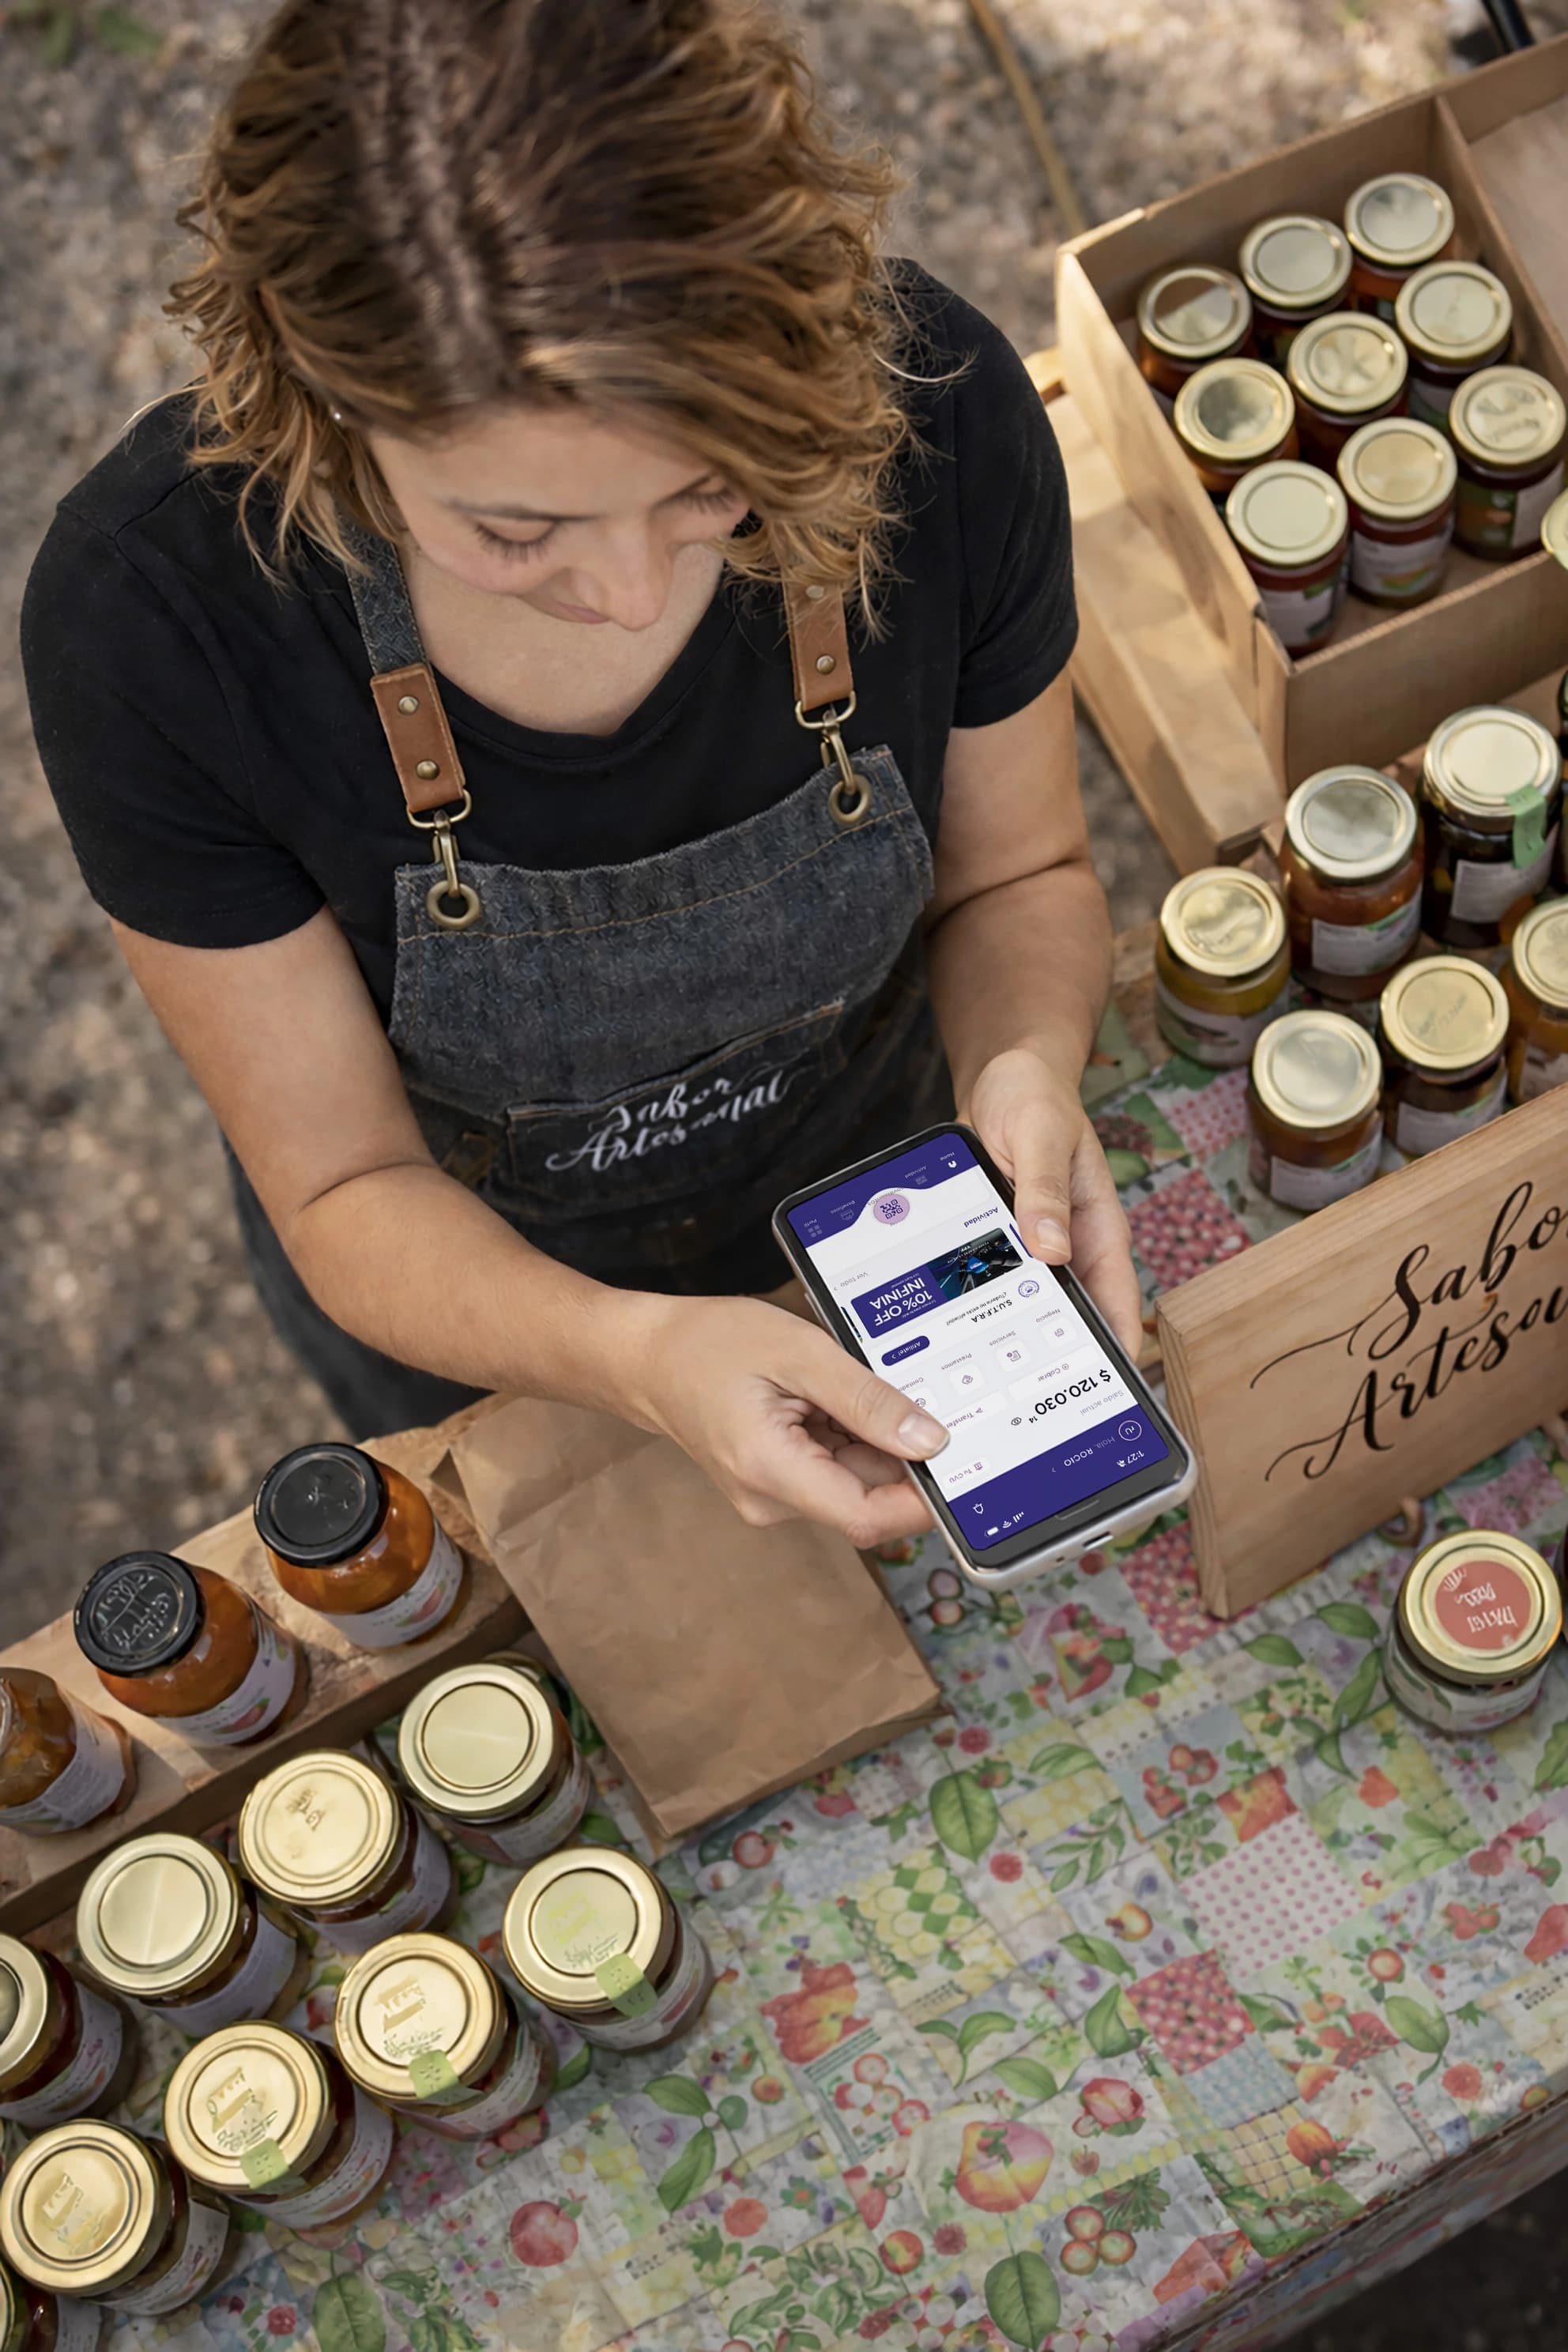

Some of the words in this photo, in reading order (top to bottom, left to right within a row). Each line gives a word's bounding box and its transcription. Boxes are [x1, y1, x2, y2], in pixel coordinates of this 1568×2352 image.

[963, 1206, 998, 1227] Actividad
[839, 1276, 856, 1287] todo
[856, 1271, 869, 1280] Ver
[869, 1277, 925, 1309] INFINIA
[1251, 1182, 1568, 1389] Sabo
[902, 1290, 932, 1310] 10%
[874, 1305, 902, 1325] OFF
[971, 1298, 1012, 1322] S.U.T.F.R.A
[1035, 1308, 1061, 1322] Negocio
[988, 1330, 1016, 1346] Servicios
[940, 1352, 972, 1370] Préstamos
[1037, 1367, 1061, 1381] Cobrar
[1099, 1368, 1111, 1382] $
[1034, 1377, 1098, 1415] 120.030
[1102, 1389, 1124, 1403] Saldo
[1079, 1400, 1102, 1415] actual
[1093, 1435, 1115, 1448] Hola,
[1063, 1447, 1093, 1466] ROCIO
[1127, 1449, 1144, 1464] 1:27
[948, 1472, 964, 1483] CVU
